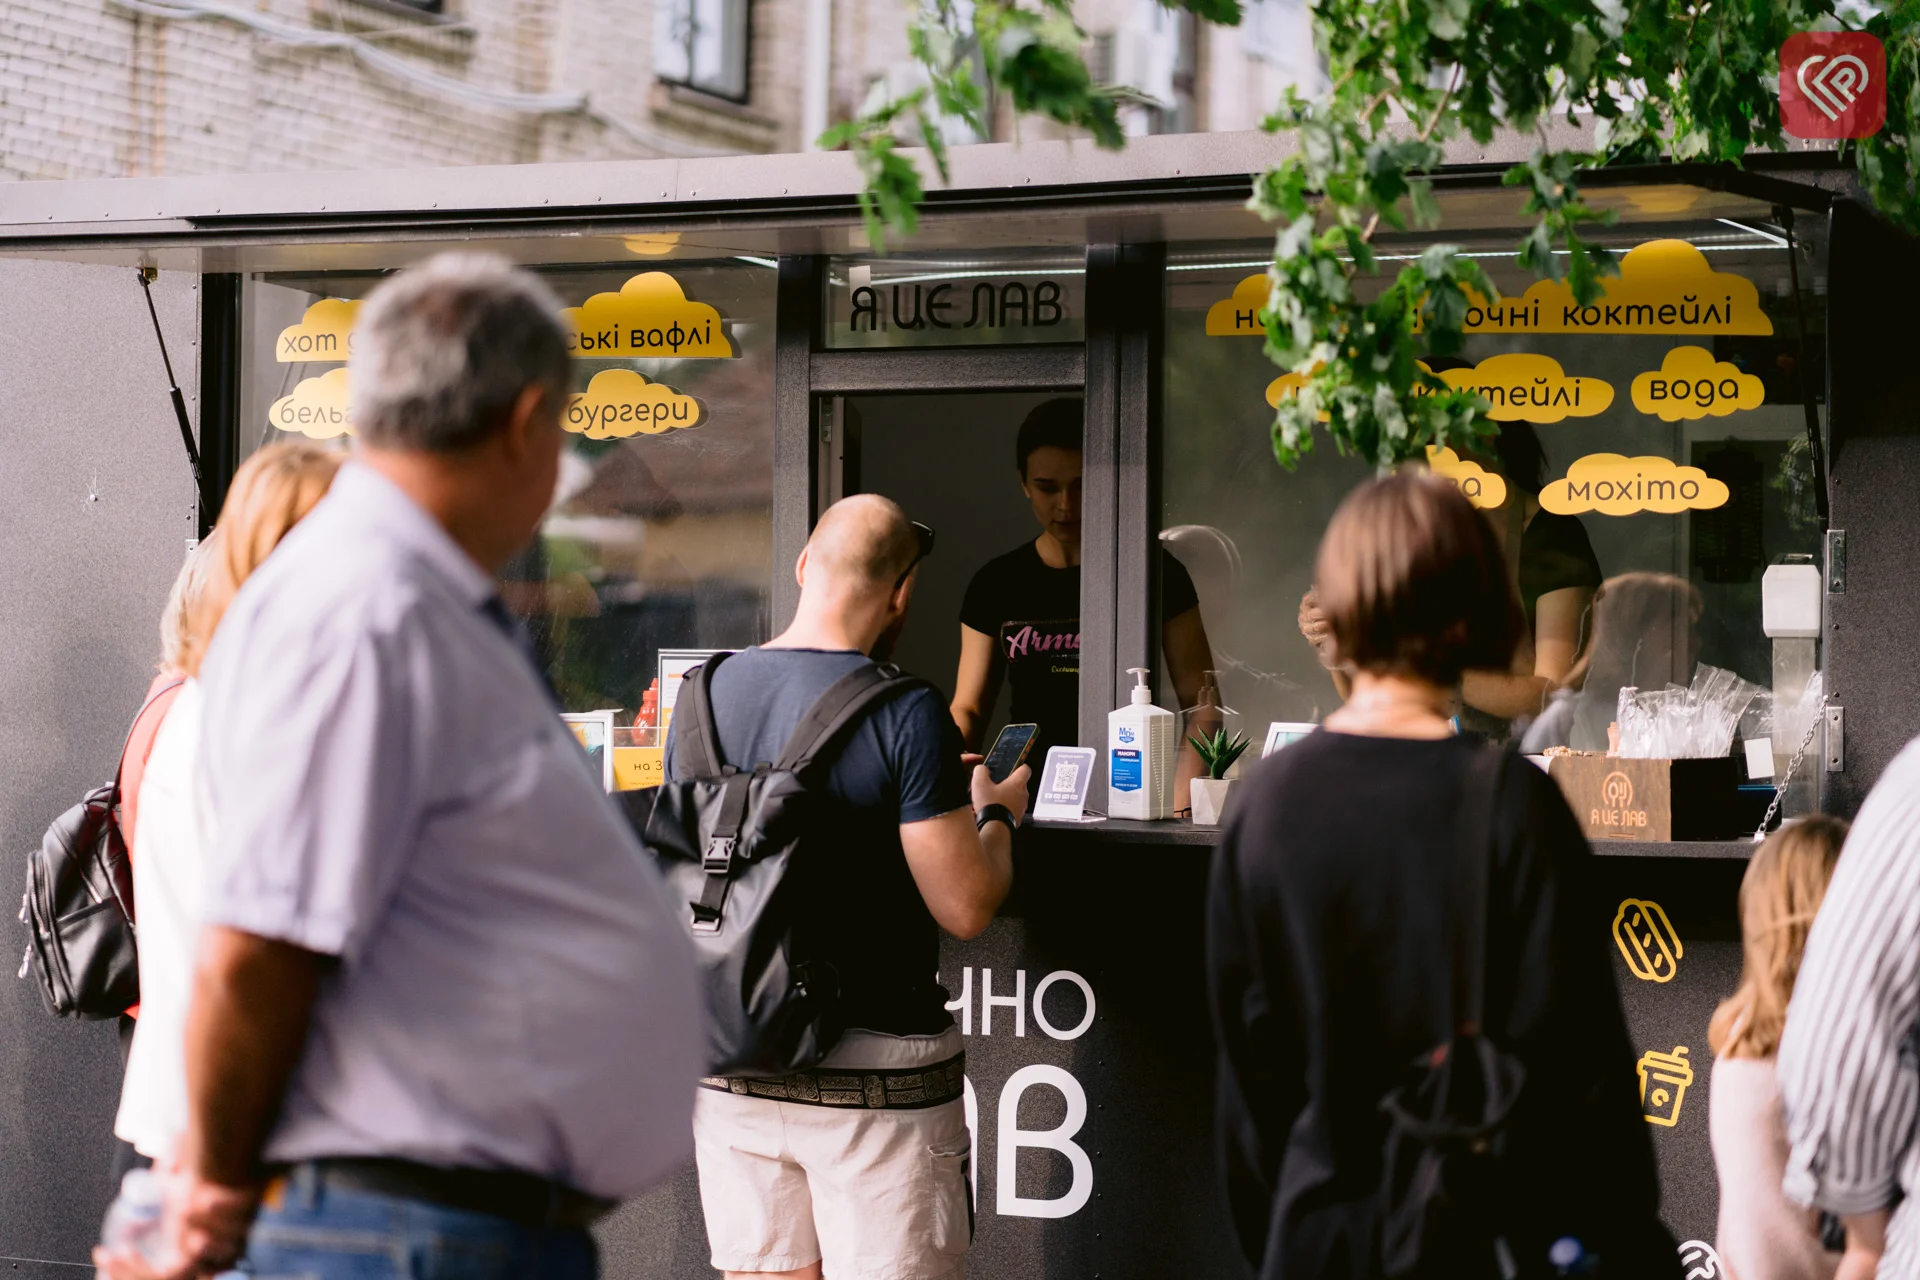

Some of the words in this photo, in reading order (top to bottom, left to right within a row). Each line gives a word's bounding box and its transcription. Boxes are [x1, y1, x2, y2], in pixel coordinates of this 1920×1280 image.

[850, 286, 877, 331] Я
[963, 281, 1063, 328] ЛАВ
[1563, 295, 1732, 327] коктейлі
[284, 333, 337, 354] хот
[630, 319, 711, 354] вафлі
[1649, 379, 1740, 408] вода
[568, 396, 688, 431] бургери
[1567, 473, 1700, 501] мохіто
